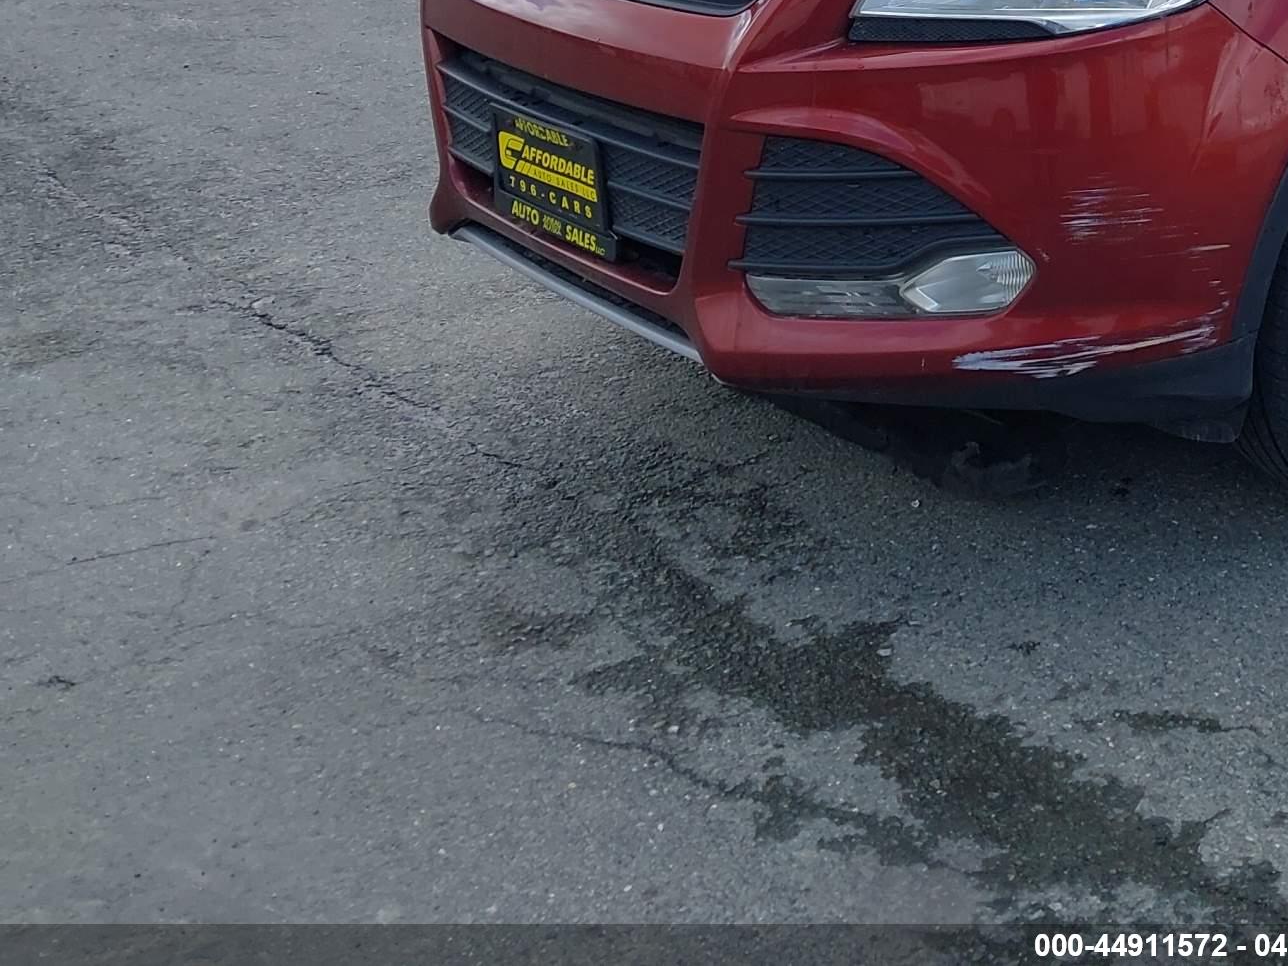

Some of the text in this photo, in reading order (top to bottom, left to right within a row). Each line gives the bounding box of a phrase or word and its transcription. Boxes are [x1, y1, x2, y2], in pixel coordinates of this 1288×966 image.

[521, 144, 594, 185] AFFORDABLE
[511, 200, 539, 225] AUTO
[565, 225, 597, 251] SALES
